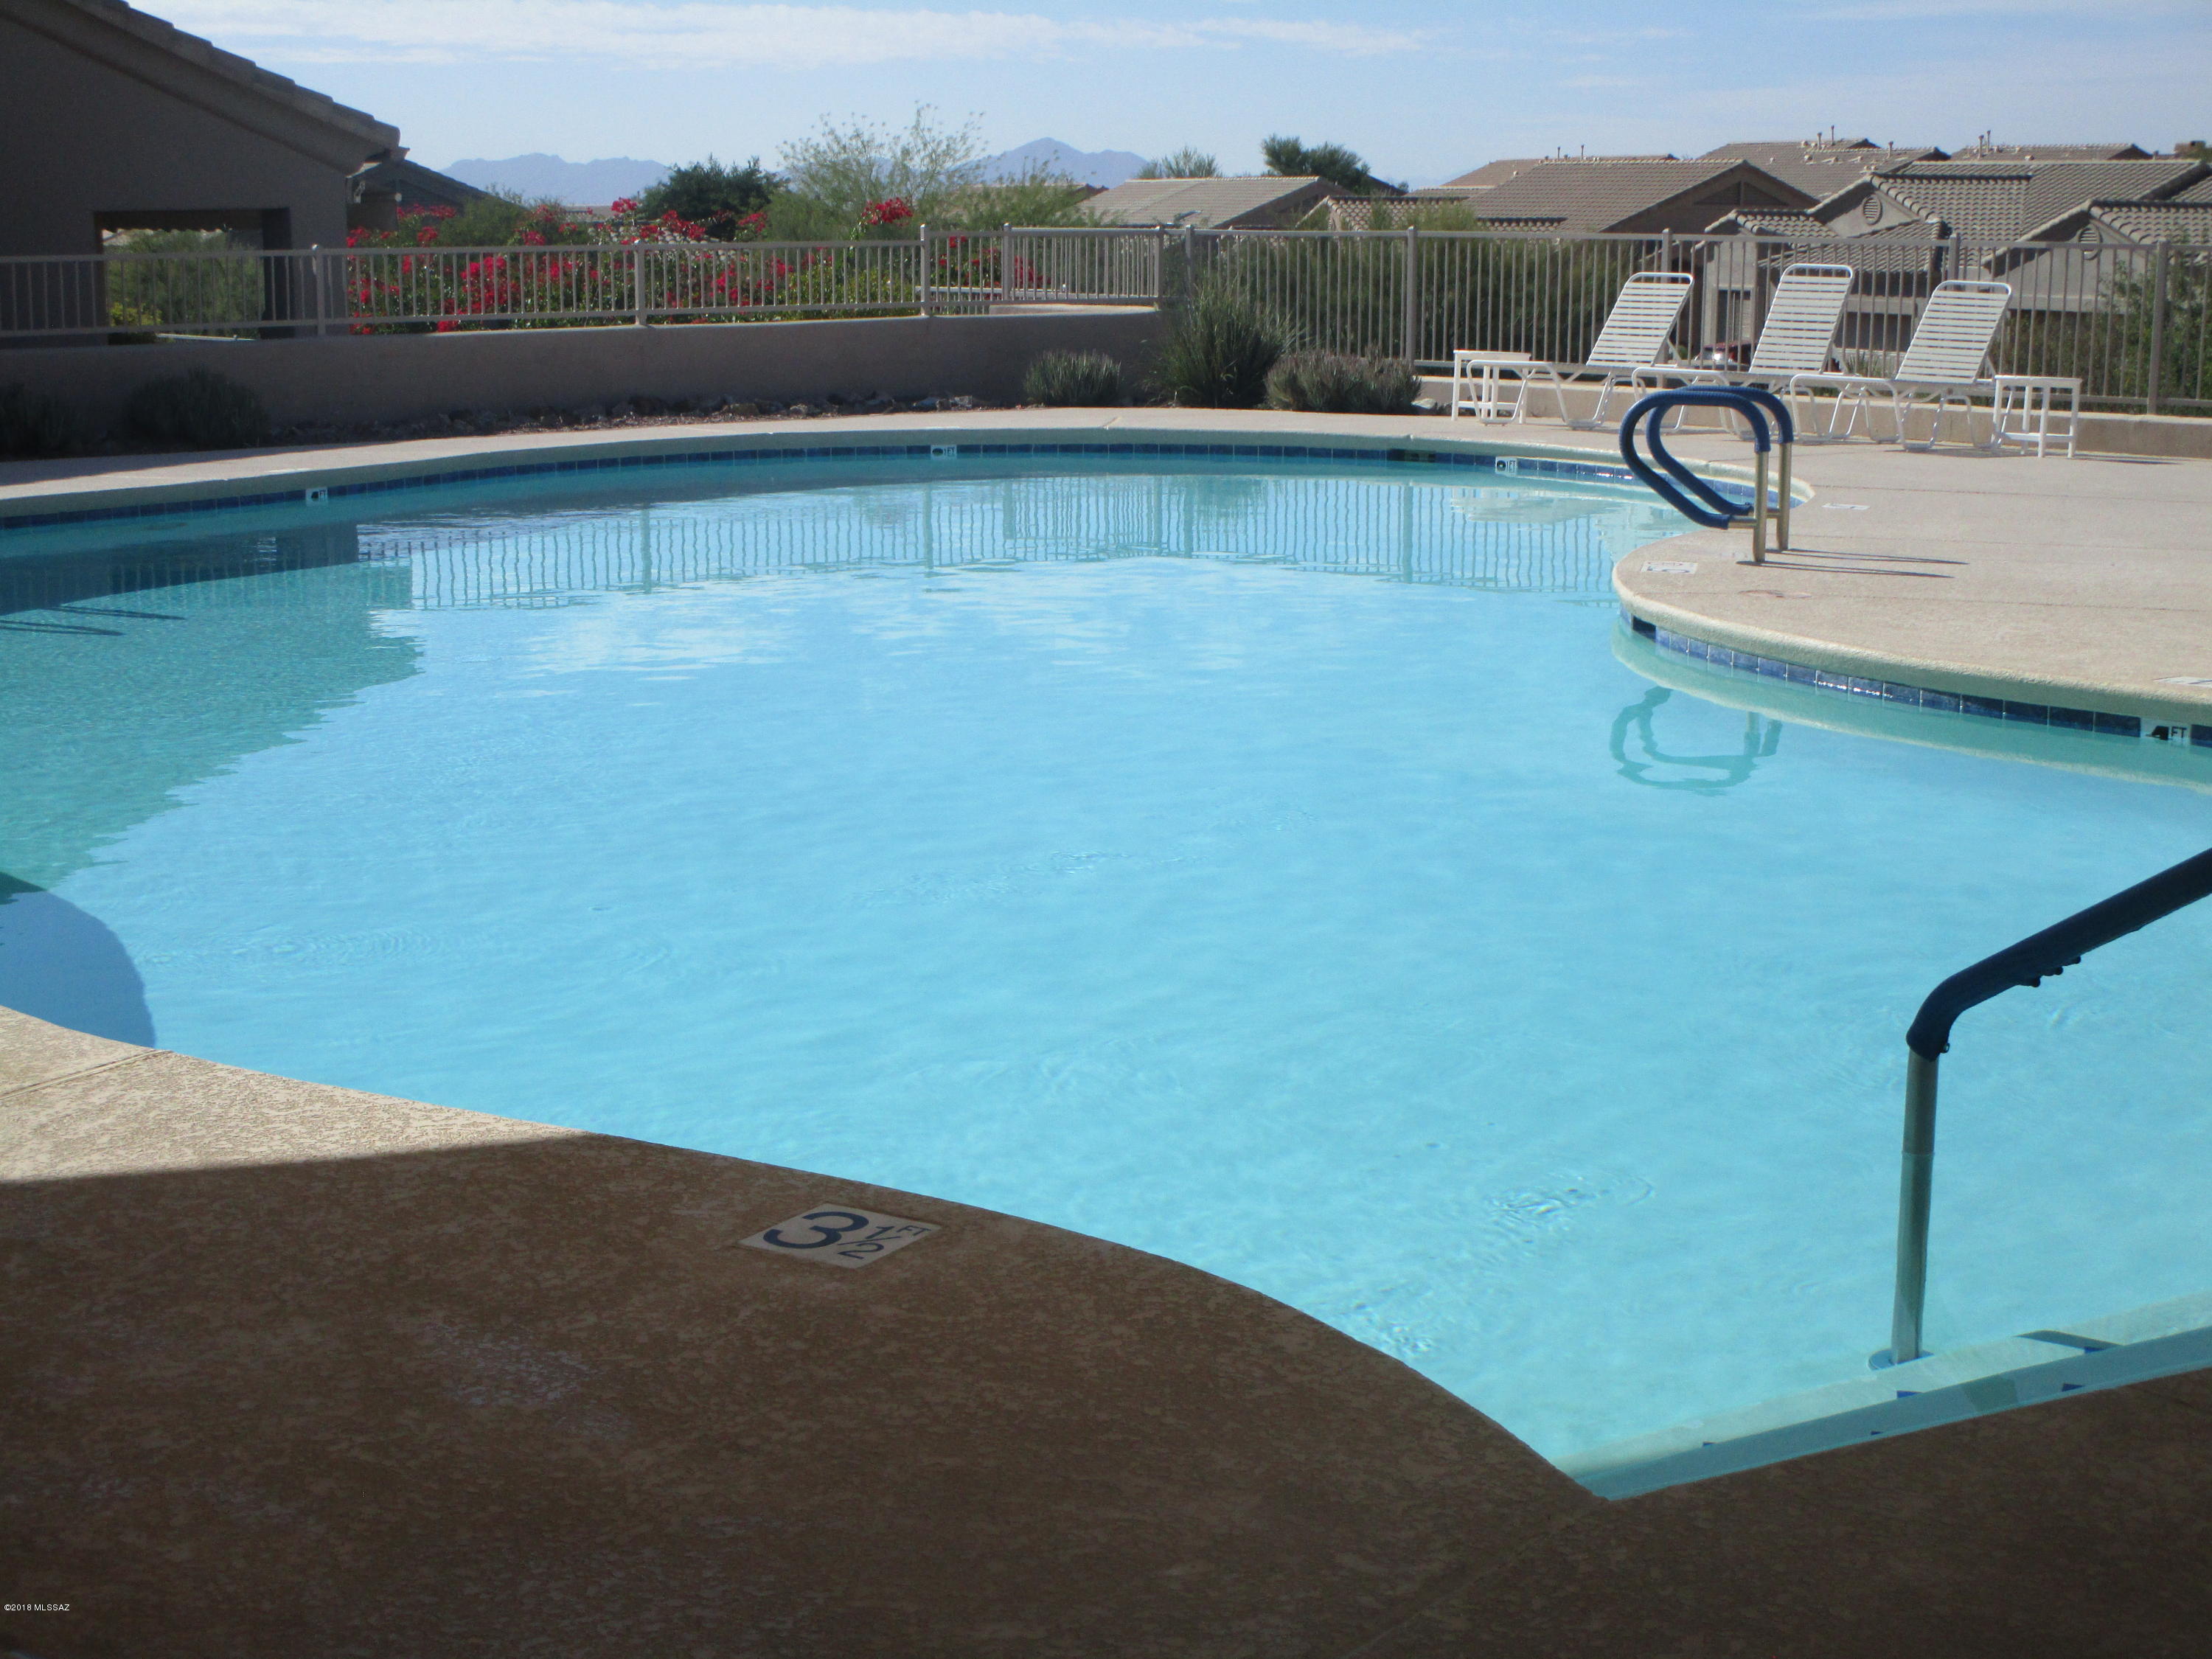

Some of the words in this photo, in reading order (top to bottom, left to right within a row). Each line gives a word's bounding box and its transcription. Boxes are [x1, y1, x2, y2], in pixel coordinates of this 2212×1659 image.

[2171, 726, 2188, 739] FT
[763, 1211, 869, 1249] 3
[897, 1225, 932, 1237] FT
